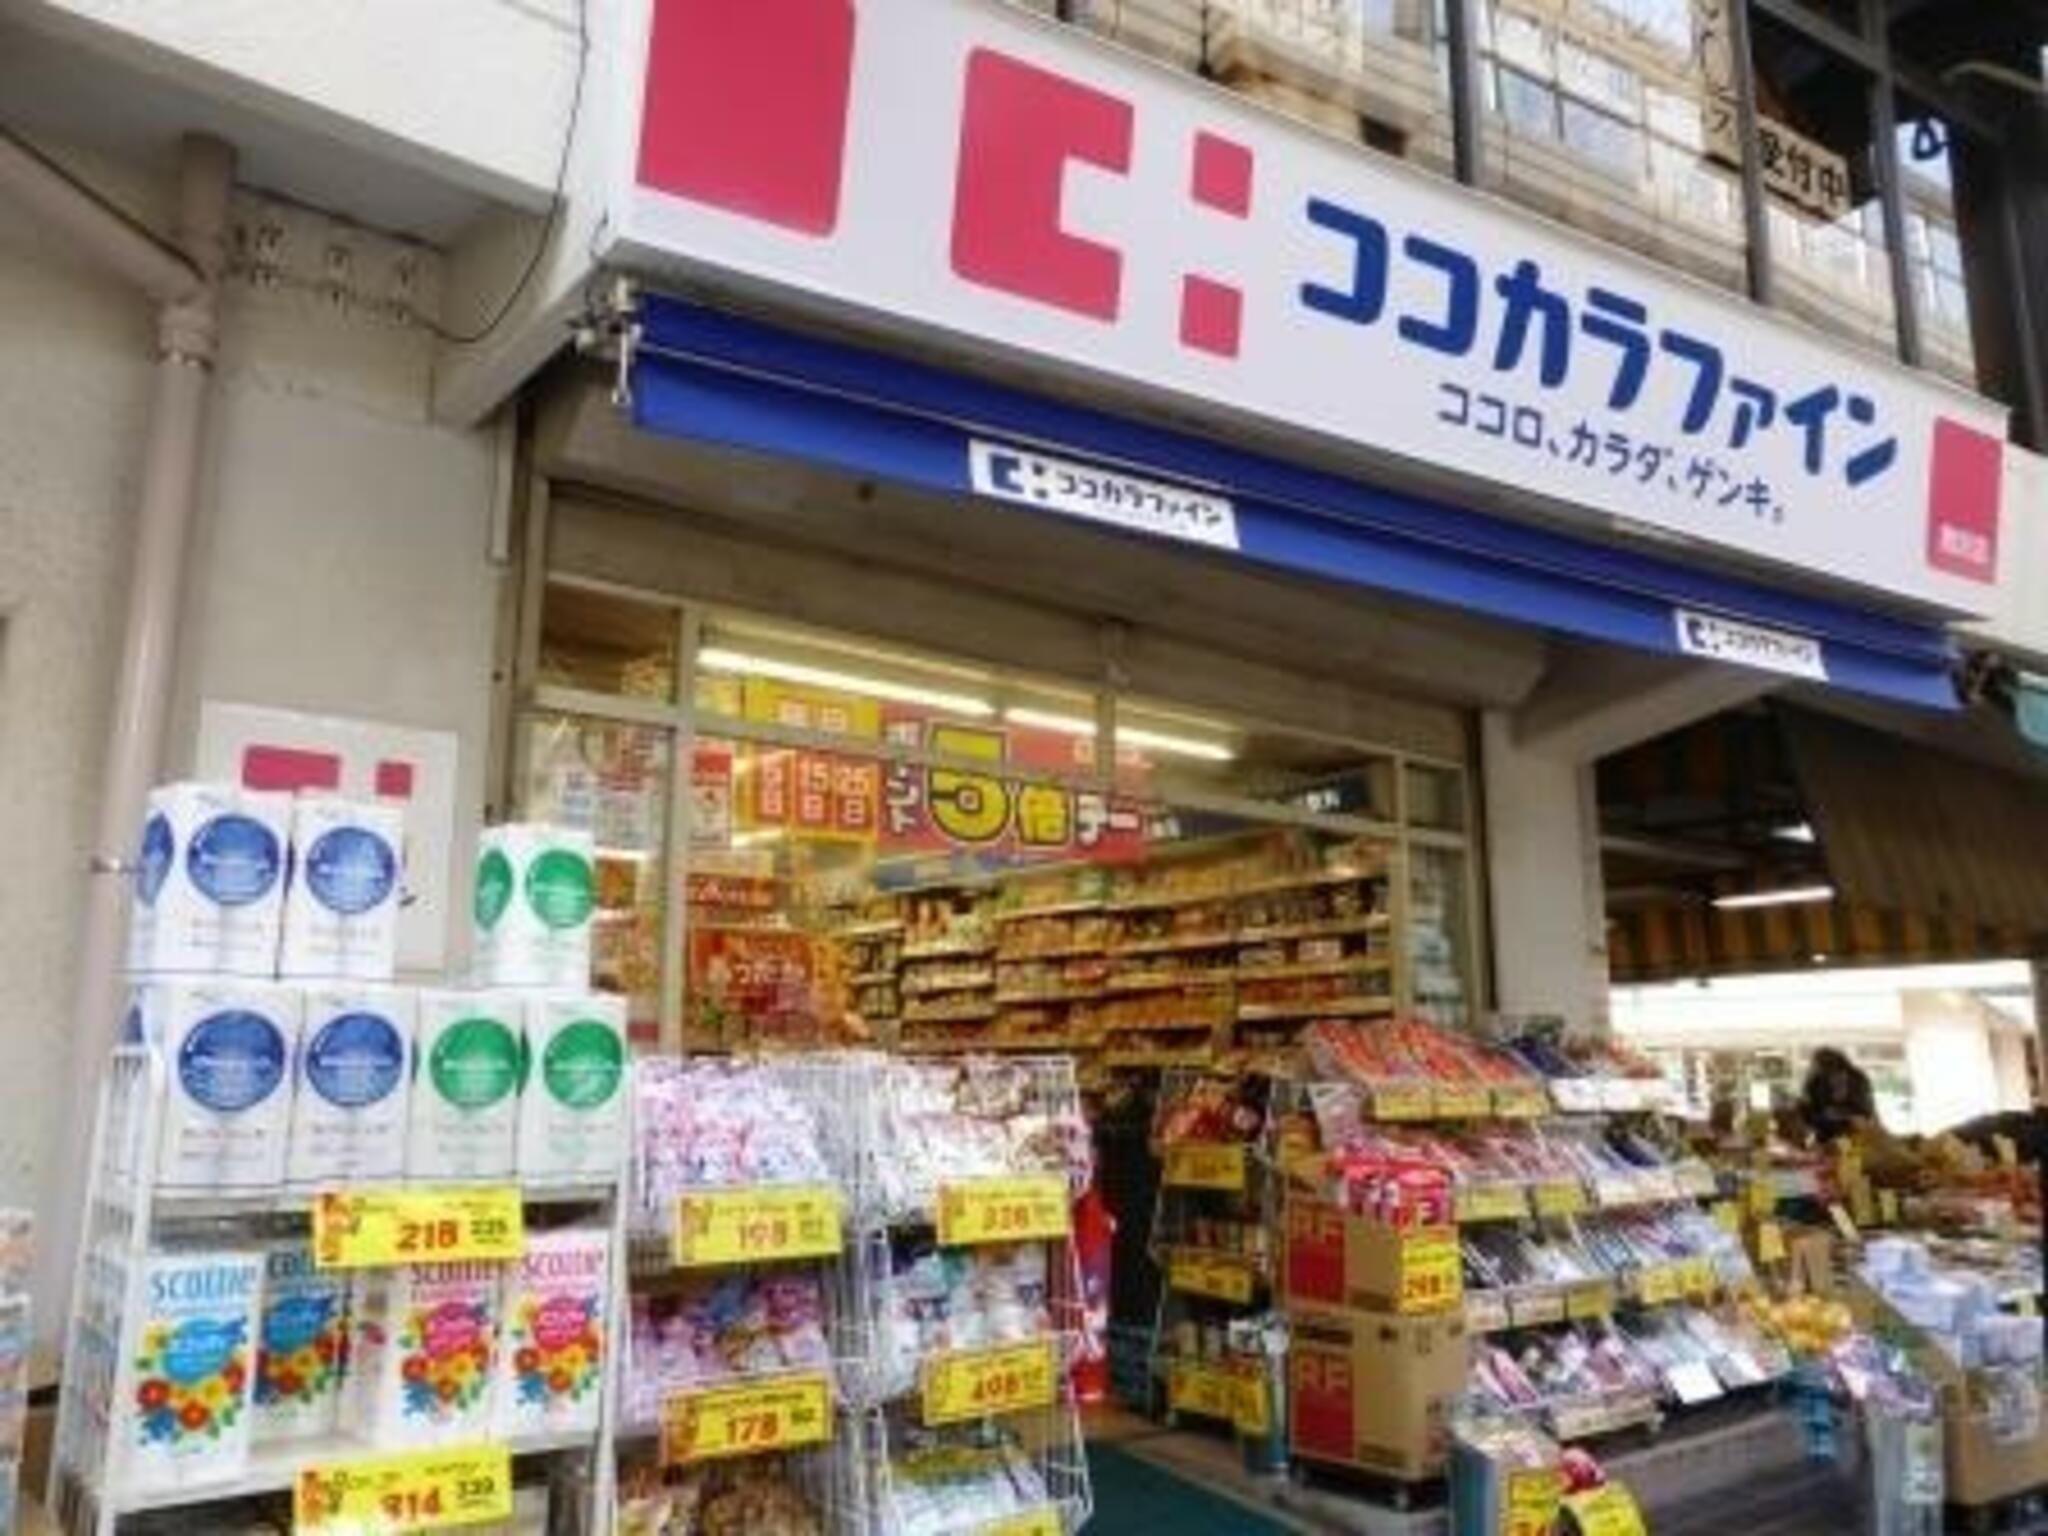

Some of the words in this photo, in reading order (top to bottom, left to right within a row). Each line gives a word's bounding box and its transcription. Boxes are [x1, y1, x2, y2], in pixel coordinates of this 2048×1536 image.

[1299, 198, 1898, 486] ココカラファイン
[1055, 469, 1223, 527] ココカラファイン
[1438, 383, 1785, 523] ココロ、カラダ、ゲンキ。
